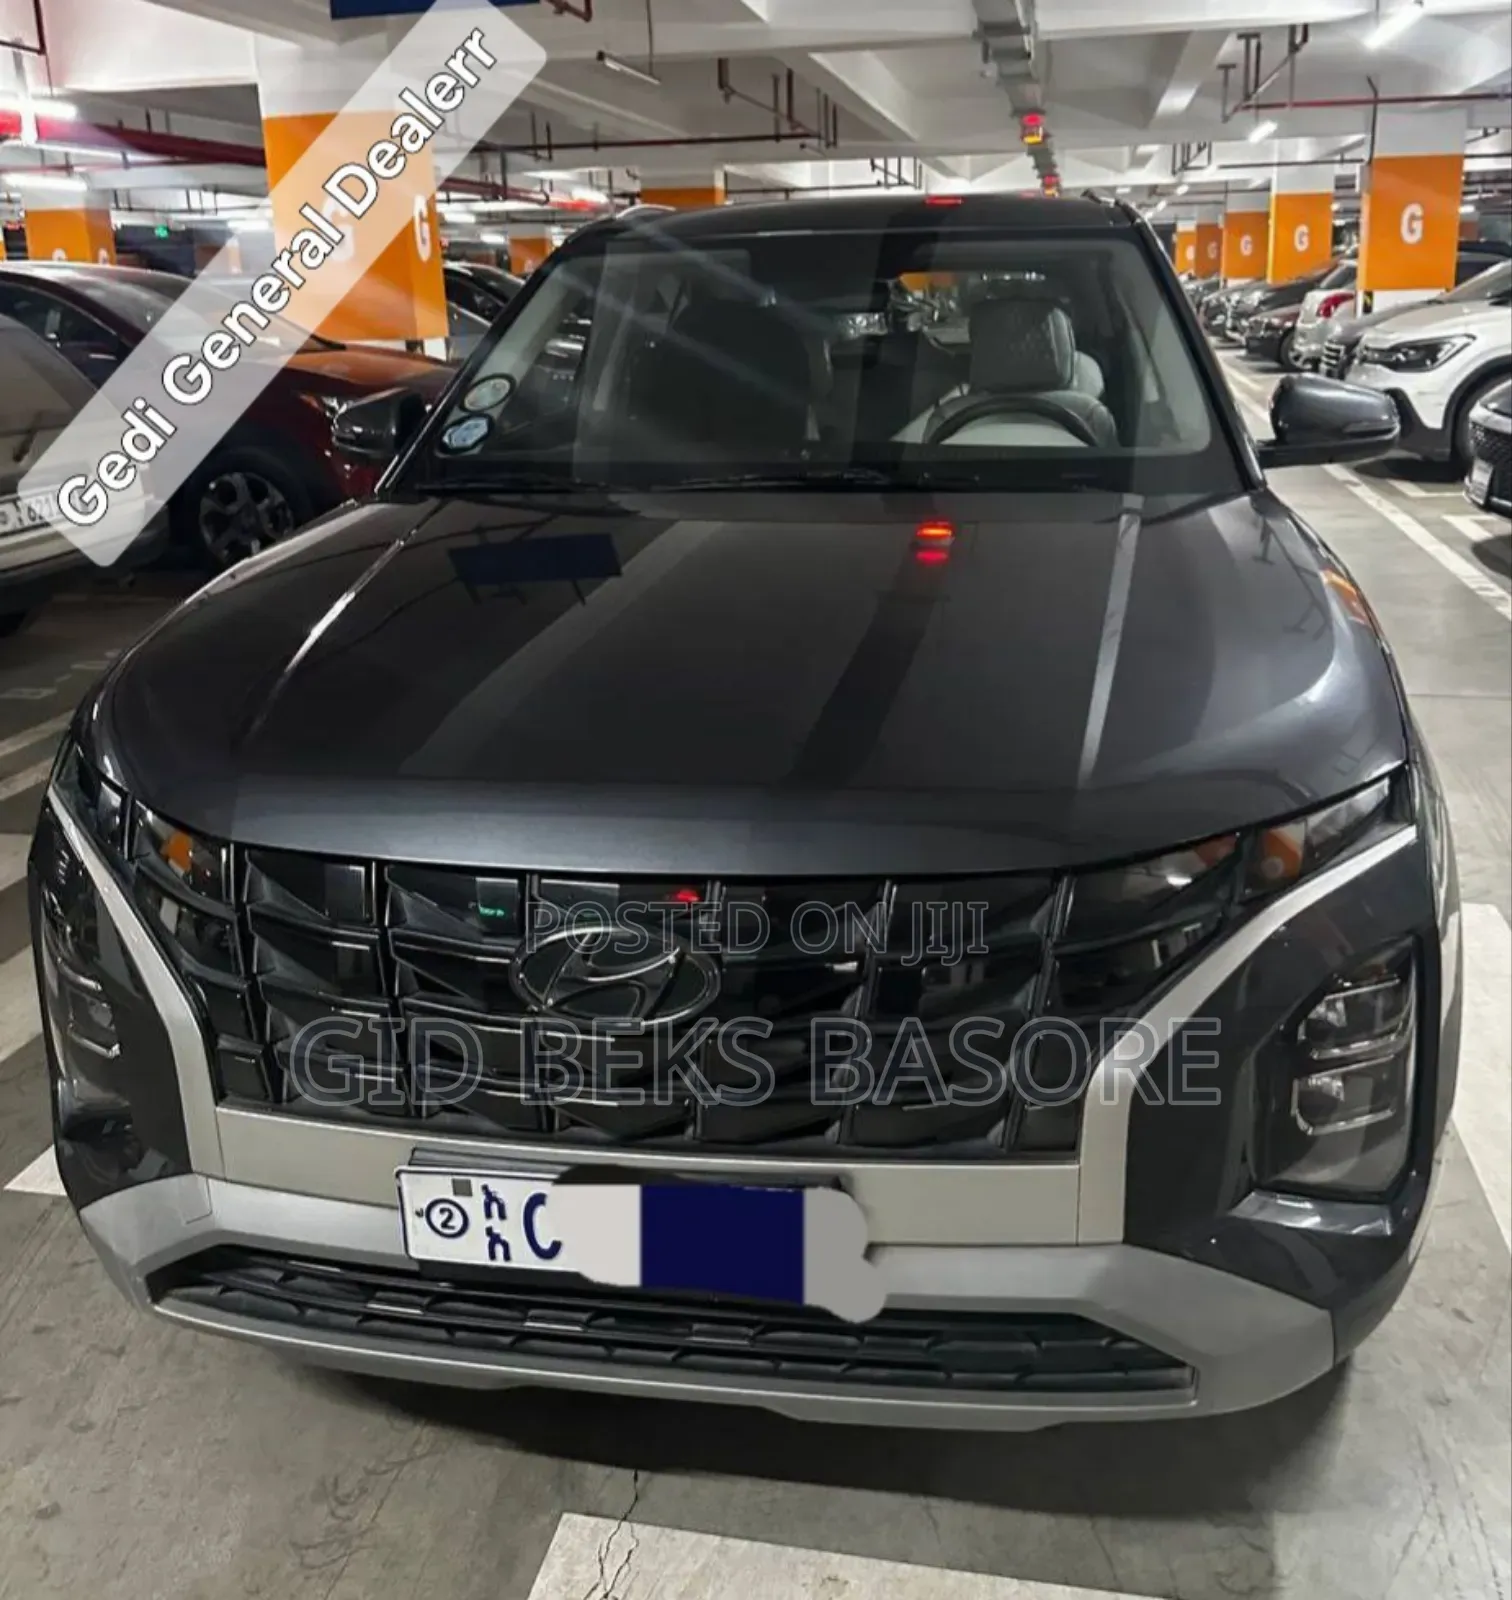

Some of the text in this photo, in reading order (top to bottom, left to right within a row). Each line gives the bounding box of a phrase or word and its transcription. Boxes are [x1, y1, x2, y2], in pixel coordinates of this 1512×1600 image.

[412, 194, 431, 263] G
[1294, 224, 1309, 252] G
[1401, 203, 1423, 244] G
[1240, 234, 1253, 256] G
